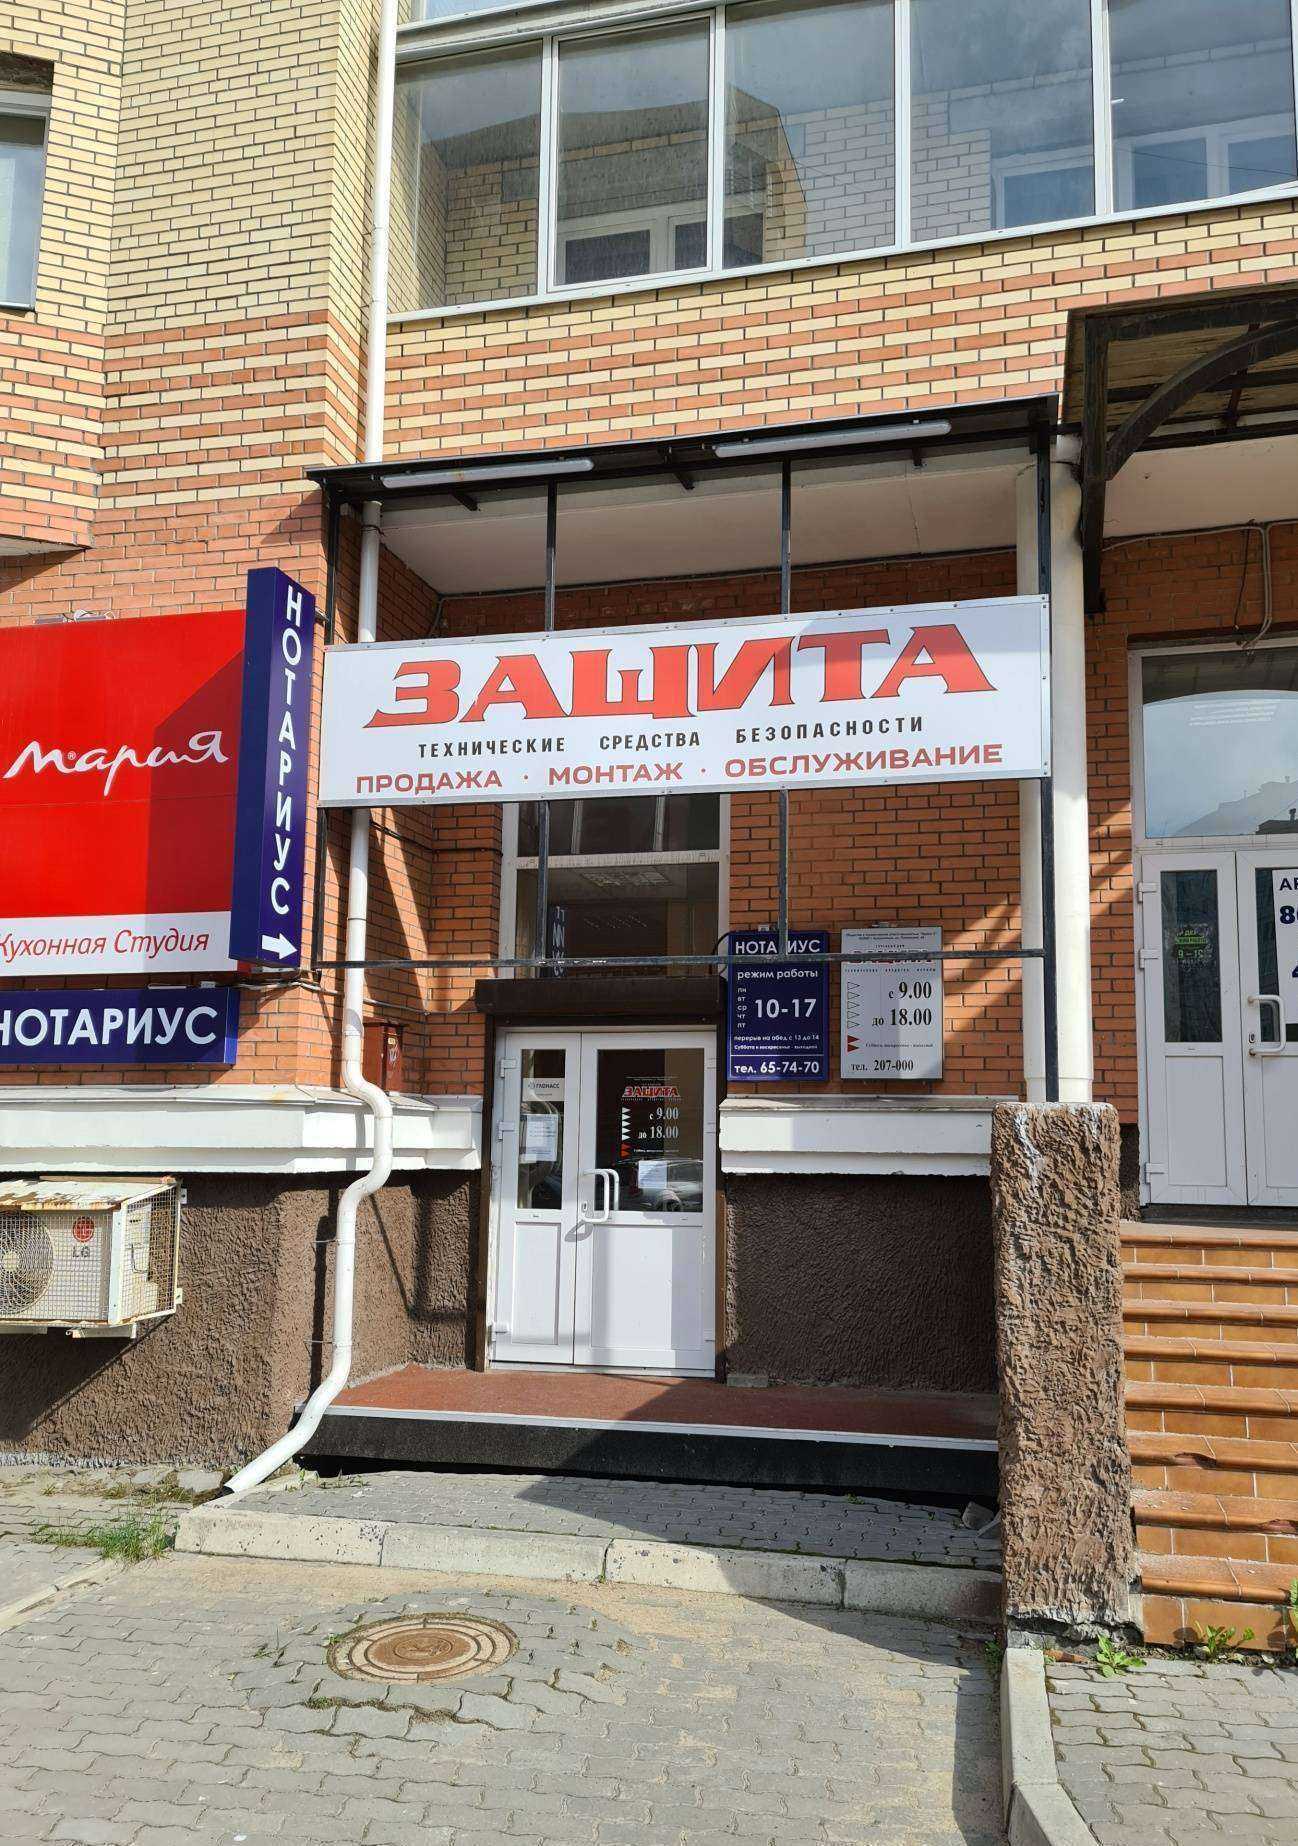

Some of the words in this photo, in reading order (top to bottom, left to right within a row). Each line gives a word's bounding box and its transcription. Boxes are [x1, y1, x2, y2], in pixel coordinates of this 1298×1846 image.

[363, 623, 999, 728] ЗАЩИТА
[419, 737, 566, 758] ТЕХНИЧЕСКИЕ
[599, 730, 700, 751] СРЕДСТВА
[736, 716, 923, 743] БЕЗОПАСНОСТИ
[271, 585, 301, 915] НОТАРИУС
[356, 769, 503, 795] ПРОДАЖА
[549, 762, 684, 786] МОНТАЖ
[724, 743, 1003, 778] ОБСЛУЖИВАНИЕ
[114, 927, 210, 959] Студия
[735, 940, 820, 954] НОТАИУС
[737, 971, 774, 980] режим
[777, 968, 818, 980] работы
[888, 990, 895, 999] с
[899, 981, 932, 999] 9.00
[754, 998, 817, 1018] 10-17
[871, 1017, 885, 1027] до
[889, 1008, 932, 1026] 18.00
[734, 1065, 757, 1073] тел.
[760, 1061, 820, 1073] 65-74-70
[851, 1063, 868, 1071] тел.
[874, 1059, 914, 1071] 207-000
[656, 1107, 679, 1120] 9.00
[638, 1131, 647, 1139] до
[650, 1125, 679, 1139] 18.00
